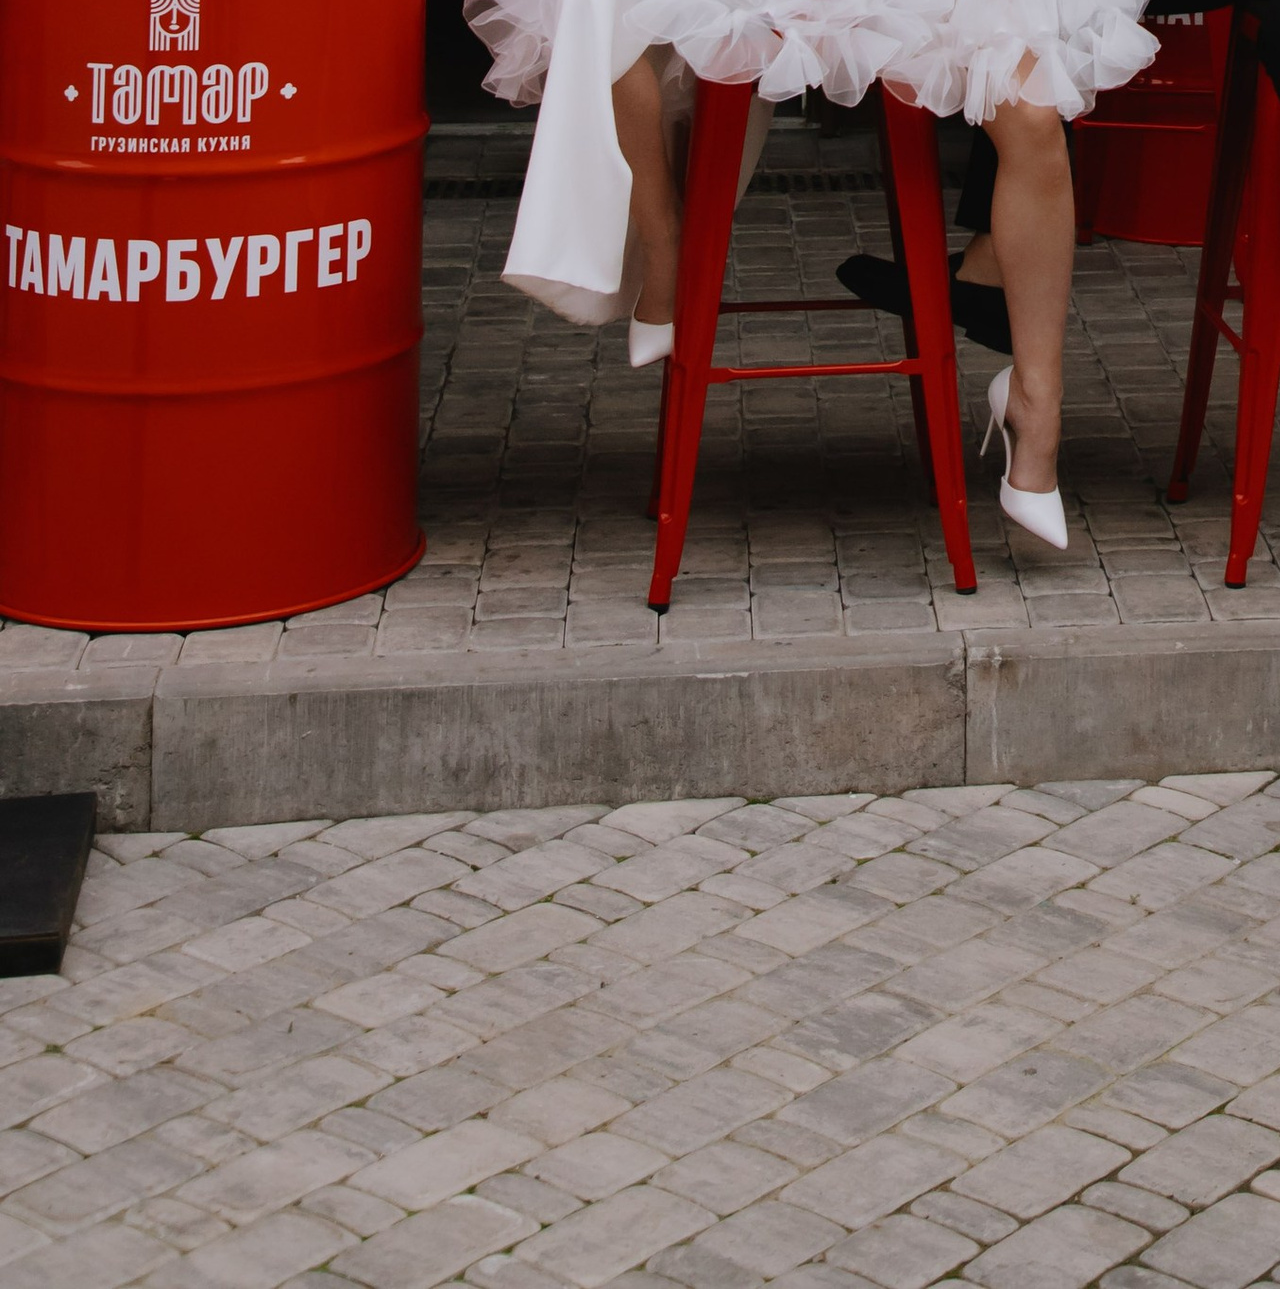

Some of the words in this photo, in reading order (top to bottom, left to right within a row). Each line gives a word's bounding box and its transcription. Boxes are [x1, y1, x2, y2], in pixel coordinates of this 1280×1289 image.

[90, 136, 191, 153] ГРУЗИНСКАЯ
[198, 135, 251, 152] КУХНЯ
[5, 218, 372, 302] ТАМАРБУРГЕР
